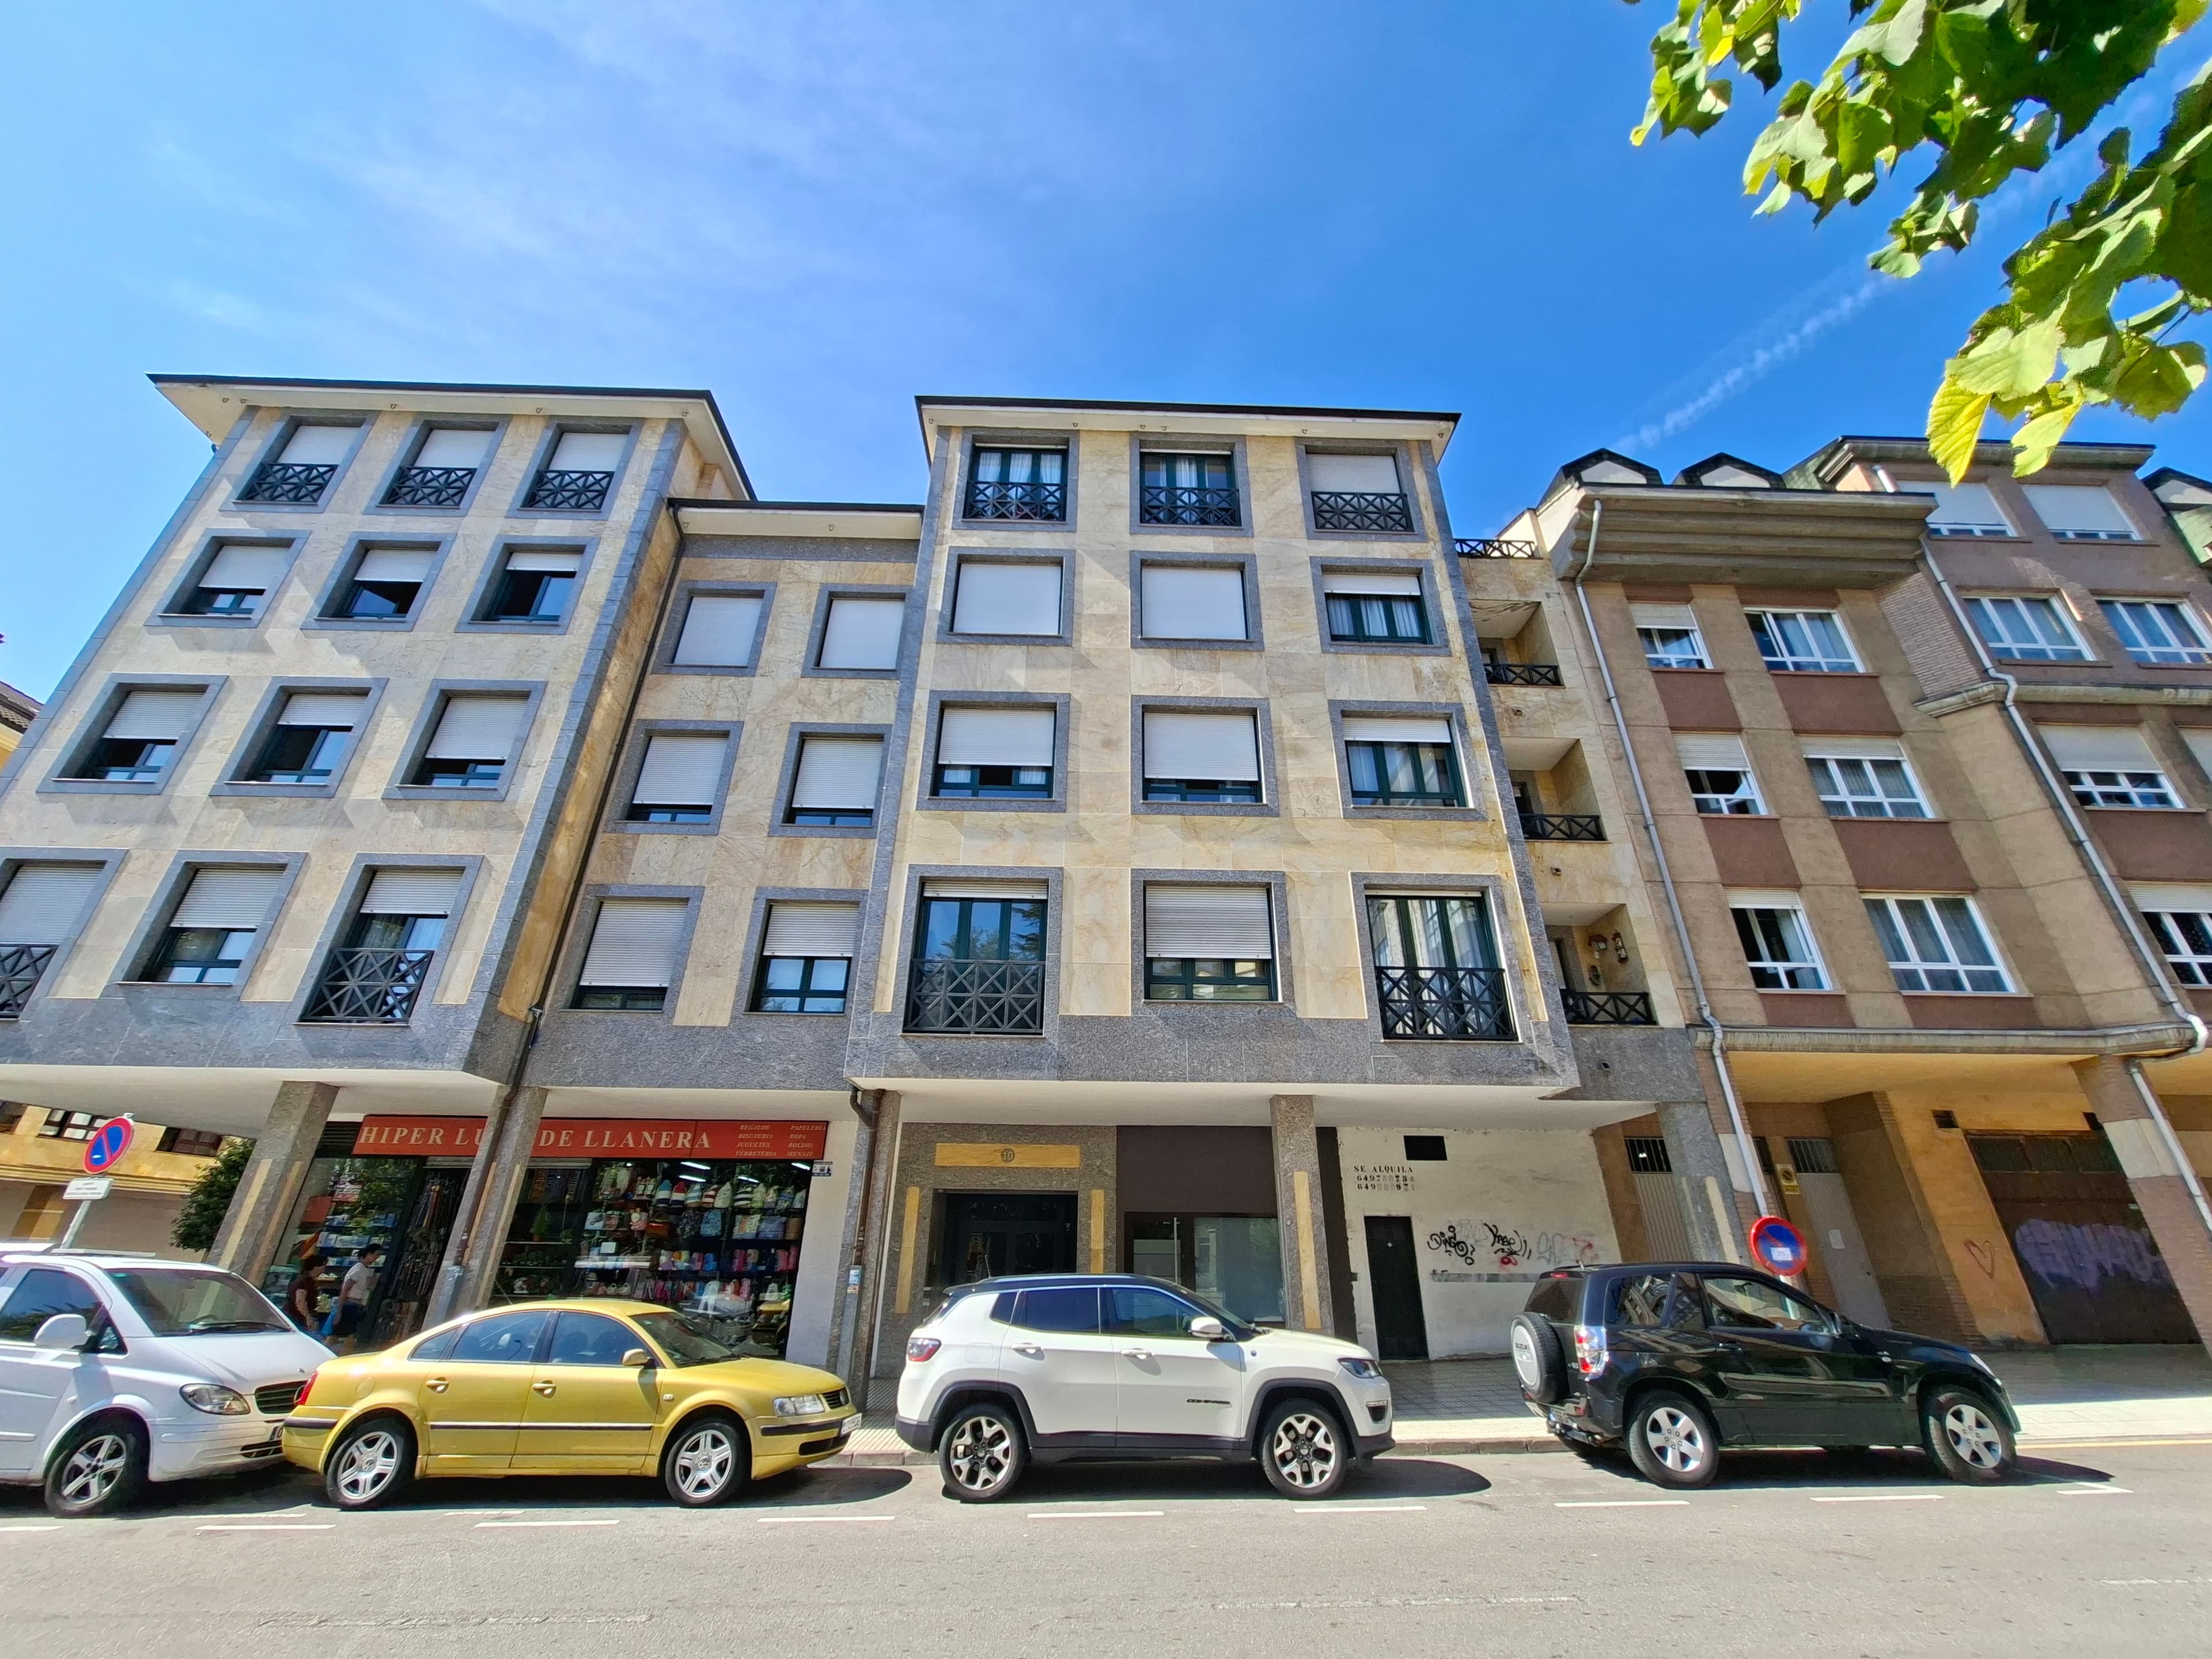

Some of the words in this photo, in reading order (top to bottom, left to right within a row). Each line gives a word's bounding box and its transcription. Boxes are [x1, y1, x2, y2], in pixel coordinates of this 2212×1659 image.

[358, 1127, 445, 1145] HIPER
[539, 1130, 574, 1147] DE
[582, 1130, 711, 1149] LLANERA
[1372, 1165, 1413, 1173] ALQUILA
